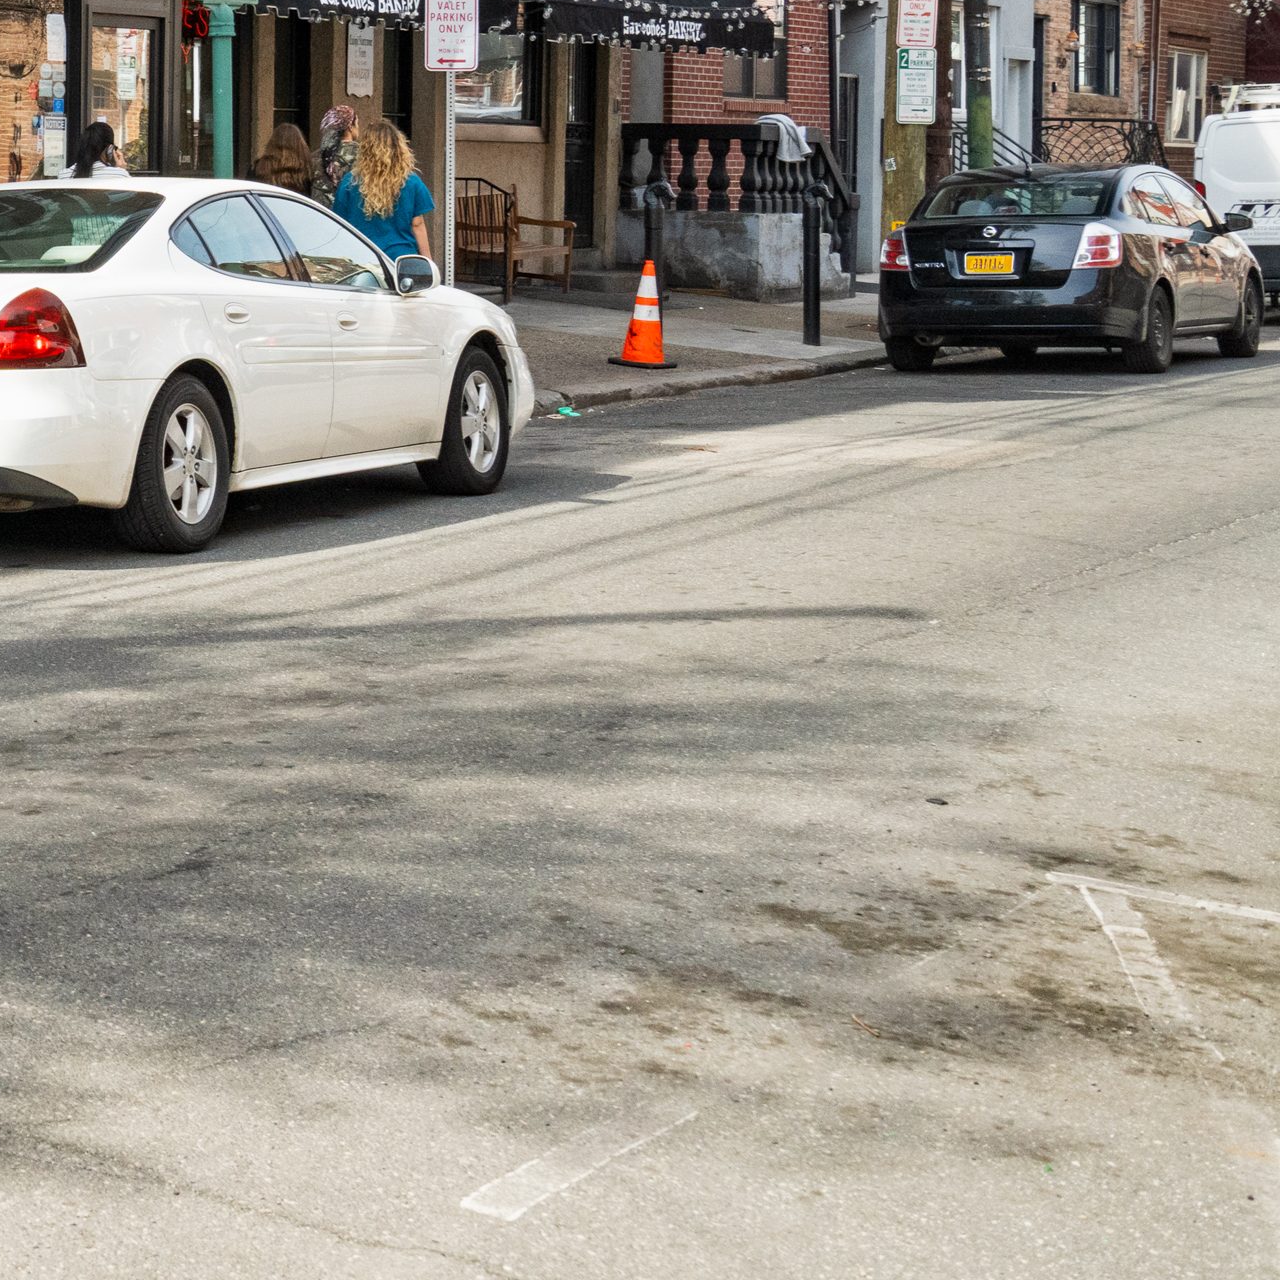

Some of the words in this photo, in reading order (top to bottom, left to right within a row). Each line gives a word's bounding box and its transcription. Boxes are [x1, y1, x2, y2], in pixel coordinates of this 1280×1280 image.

[437, 1, 466, 10] VALET
[910, 2, 926, 10] ONLY
[430, 12, 473, 21] PARKING
[439, 24, 464, 33] ONLY
[667, 20, 702, 42] BAKERY
[901, 53, 908, 67] 2
[45, 120, 65, 129] NOTICE
